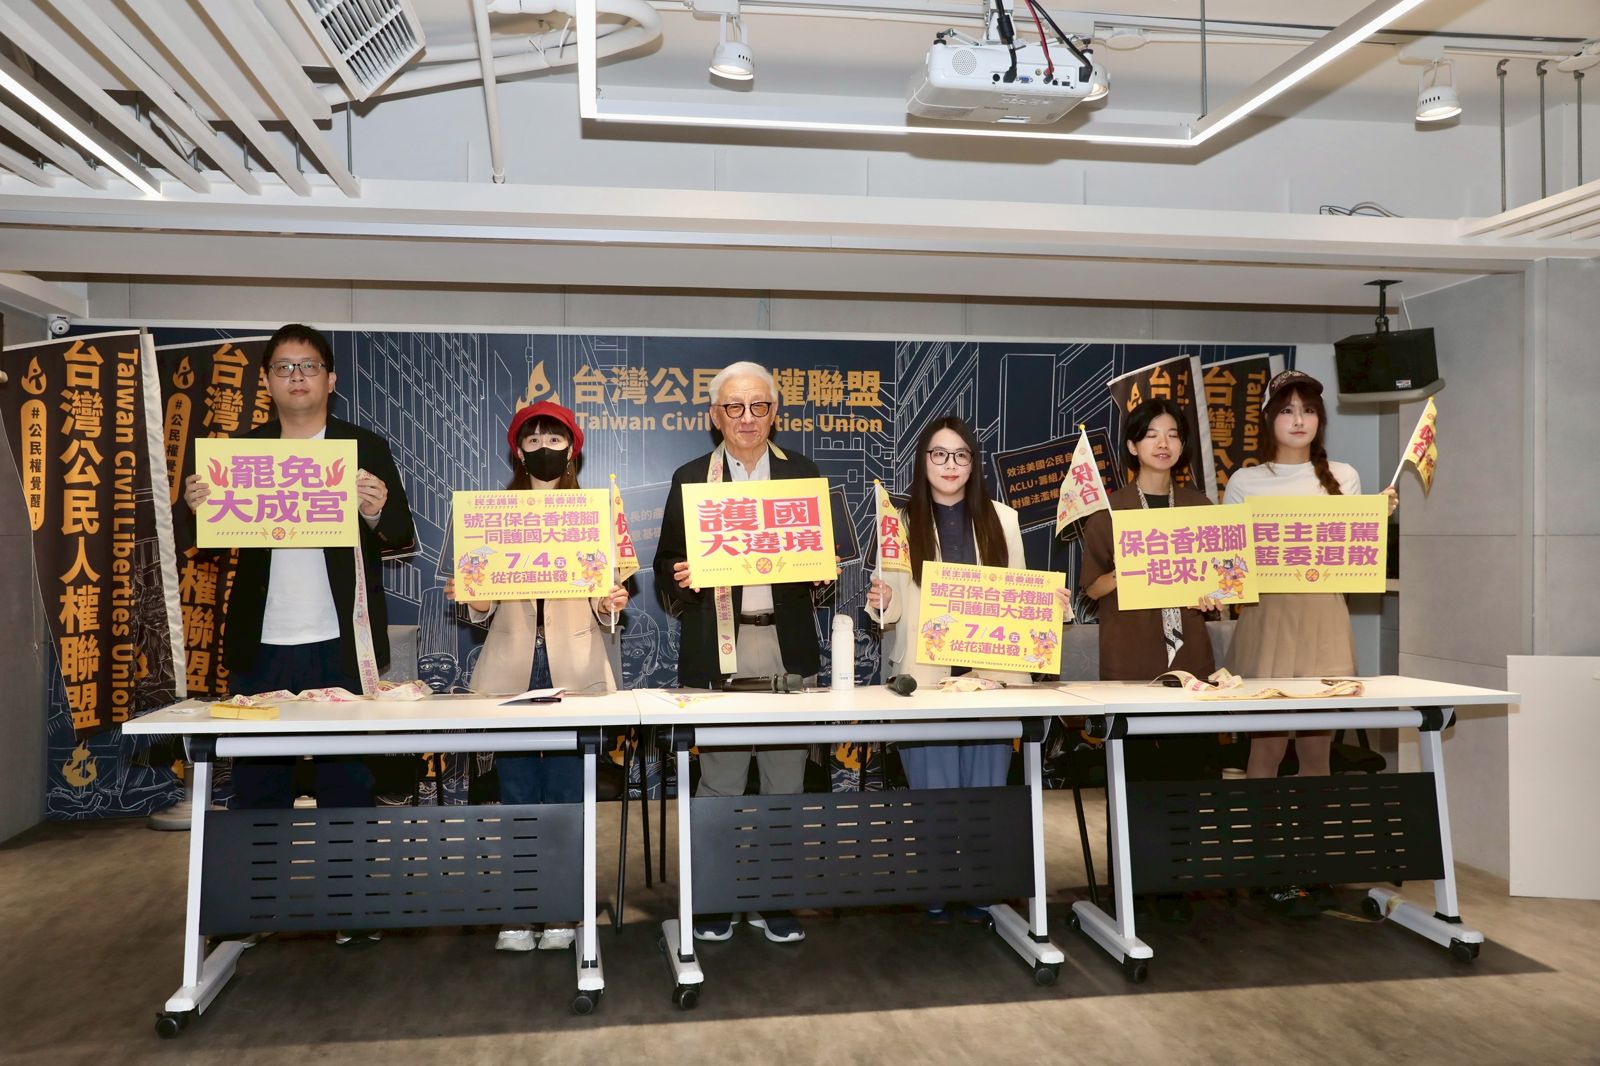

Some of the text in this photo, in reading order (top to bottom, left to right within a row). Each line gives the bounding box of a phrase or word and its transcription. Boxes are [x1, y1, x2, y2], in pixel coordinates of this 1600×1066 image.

[573, 364, 882, 408] 台灣公民權聯盟
[576, 411, 712, 432] Taiwan Civil
[819, 413, 883, 433] Union
[1243, 370, 1266, 451] Taiwan
[230, 455, 324, 489] 罷免
[1007, 444, 1103, 477] 效法美國公民自盟
[206, 489, 348, 524] 大成宮
[463, 510, 599, 529] 號召保台香燈腳
[696, 496, 821, 534] 護國
[59, 339, 104, 730] 台灣公民人權聯盟
[111, 348, 139, 723] Taiwan Civil Liberties Union
[463, 527, 600, 545] 一同護國大遶境
[700, 529, 824, 558] 大遶境
[880, 514, 900, 559] 保台
[1118, 522, 1248, 559] 保台香燈腳
[1252, 521, 1380, 543] 民主護駕
[505, 551, 551, 570] 7/4
[1254, 545, 1379, 567] 藍委退散
[930, 582, 1054, 606] 號召保台香燈腳
[929, 599, 1053, 622] 一同護國大遶境
[964, 623, 1006, 641] 7/4
